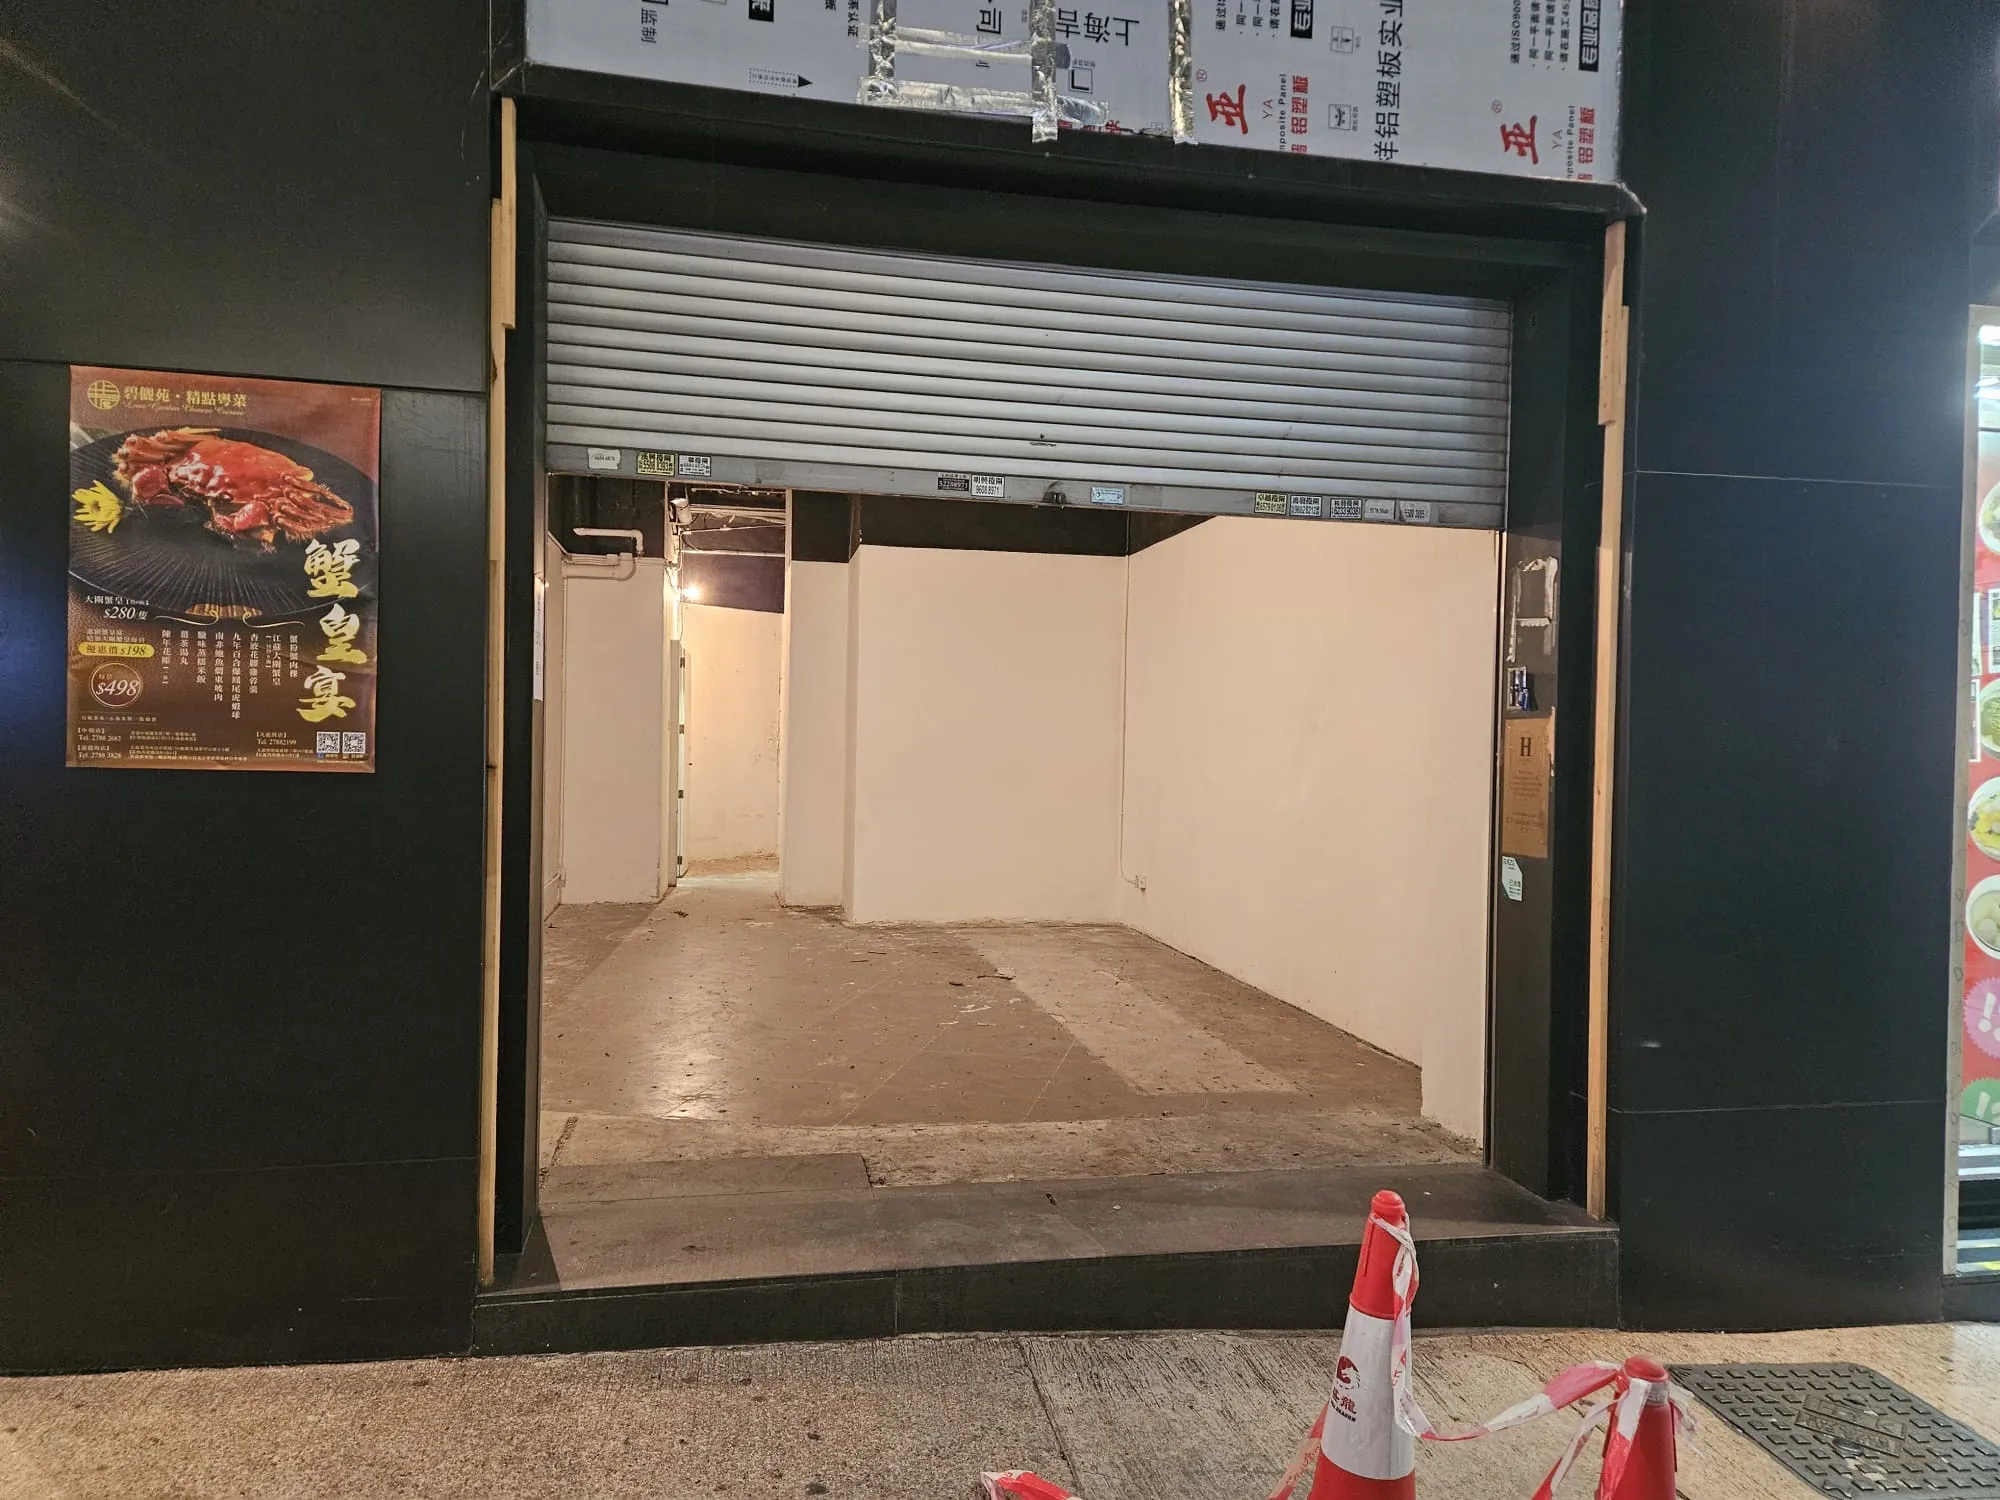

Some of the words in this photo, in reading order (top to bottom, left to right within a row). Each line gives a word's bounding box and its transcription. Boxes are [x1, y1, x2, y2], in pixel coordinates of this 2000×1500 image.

[641, 7, 657, 43] 监制
[976, 0, 1002, 34] 司
[1253, 0, 1263, 27] 同一
[1278, 73, 1287, 105] Panel
[1262, 98, 1274, 120] YA
[1567, 105, 1576, 136] Panel
[1552, 129, 1563, 150] YA
[1566, 140, 1575, 178] posite
[296, 538, 368, 722] 蟹皇宴
[96, 679, 139, 696] $498
